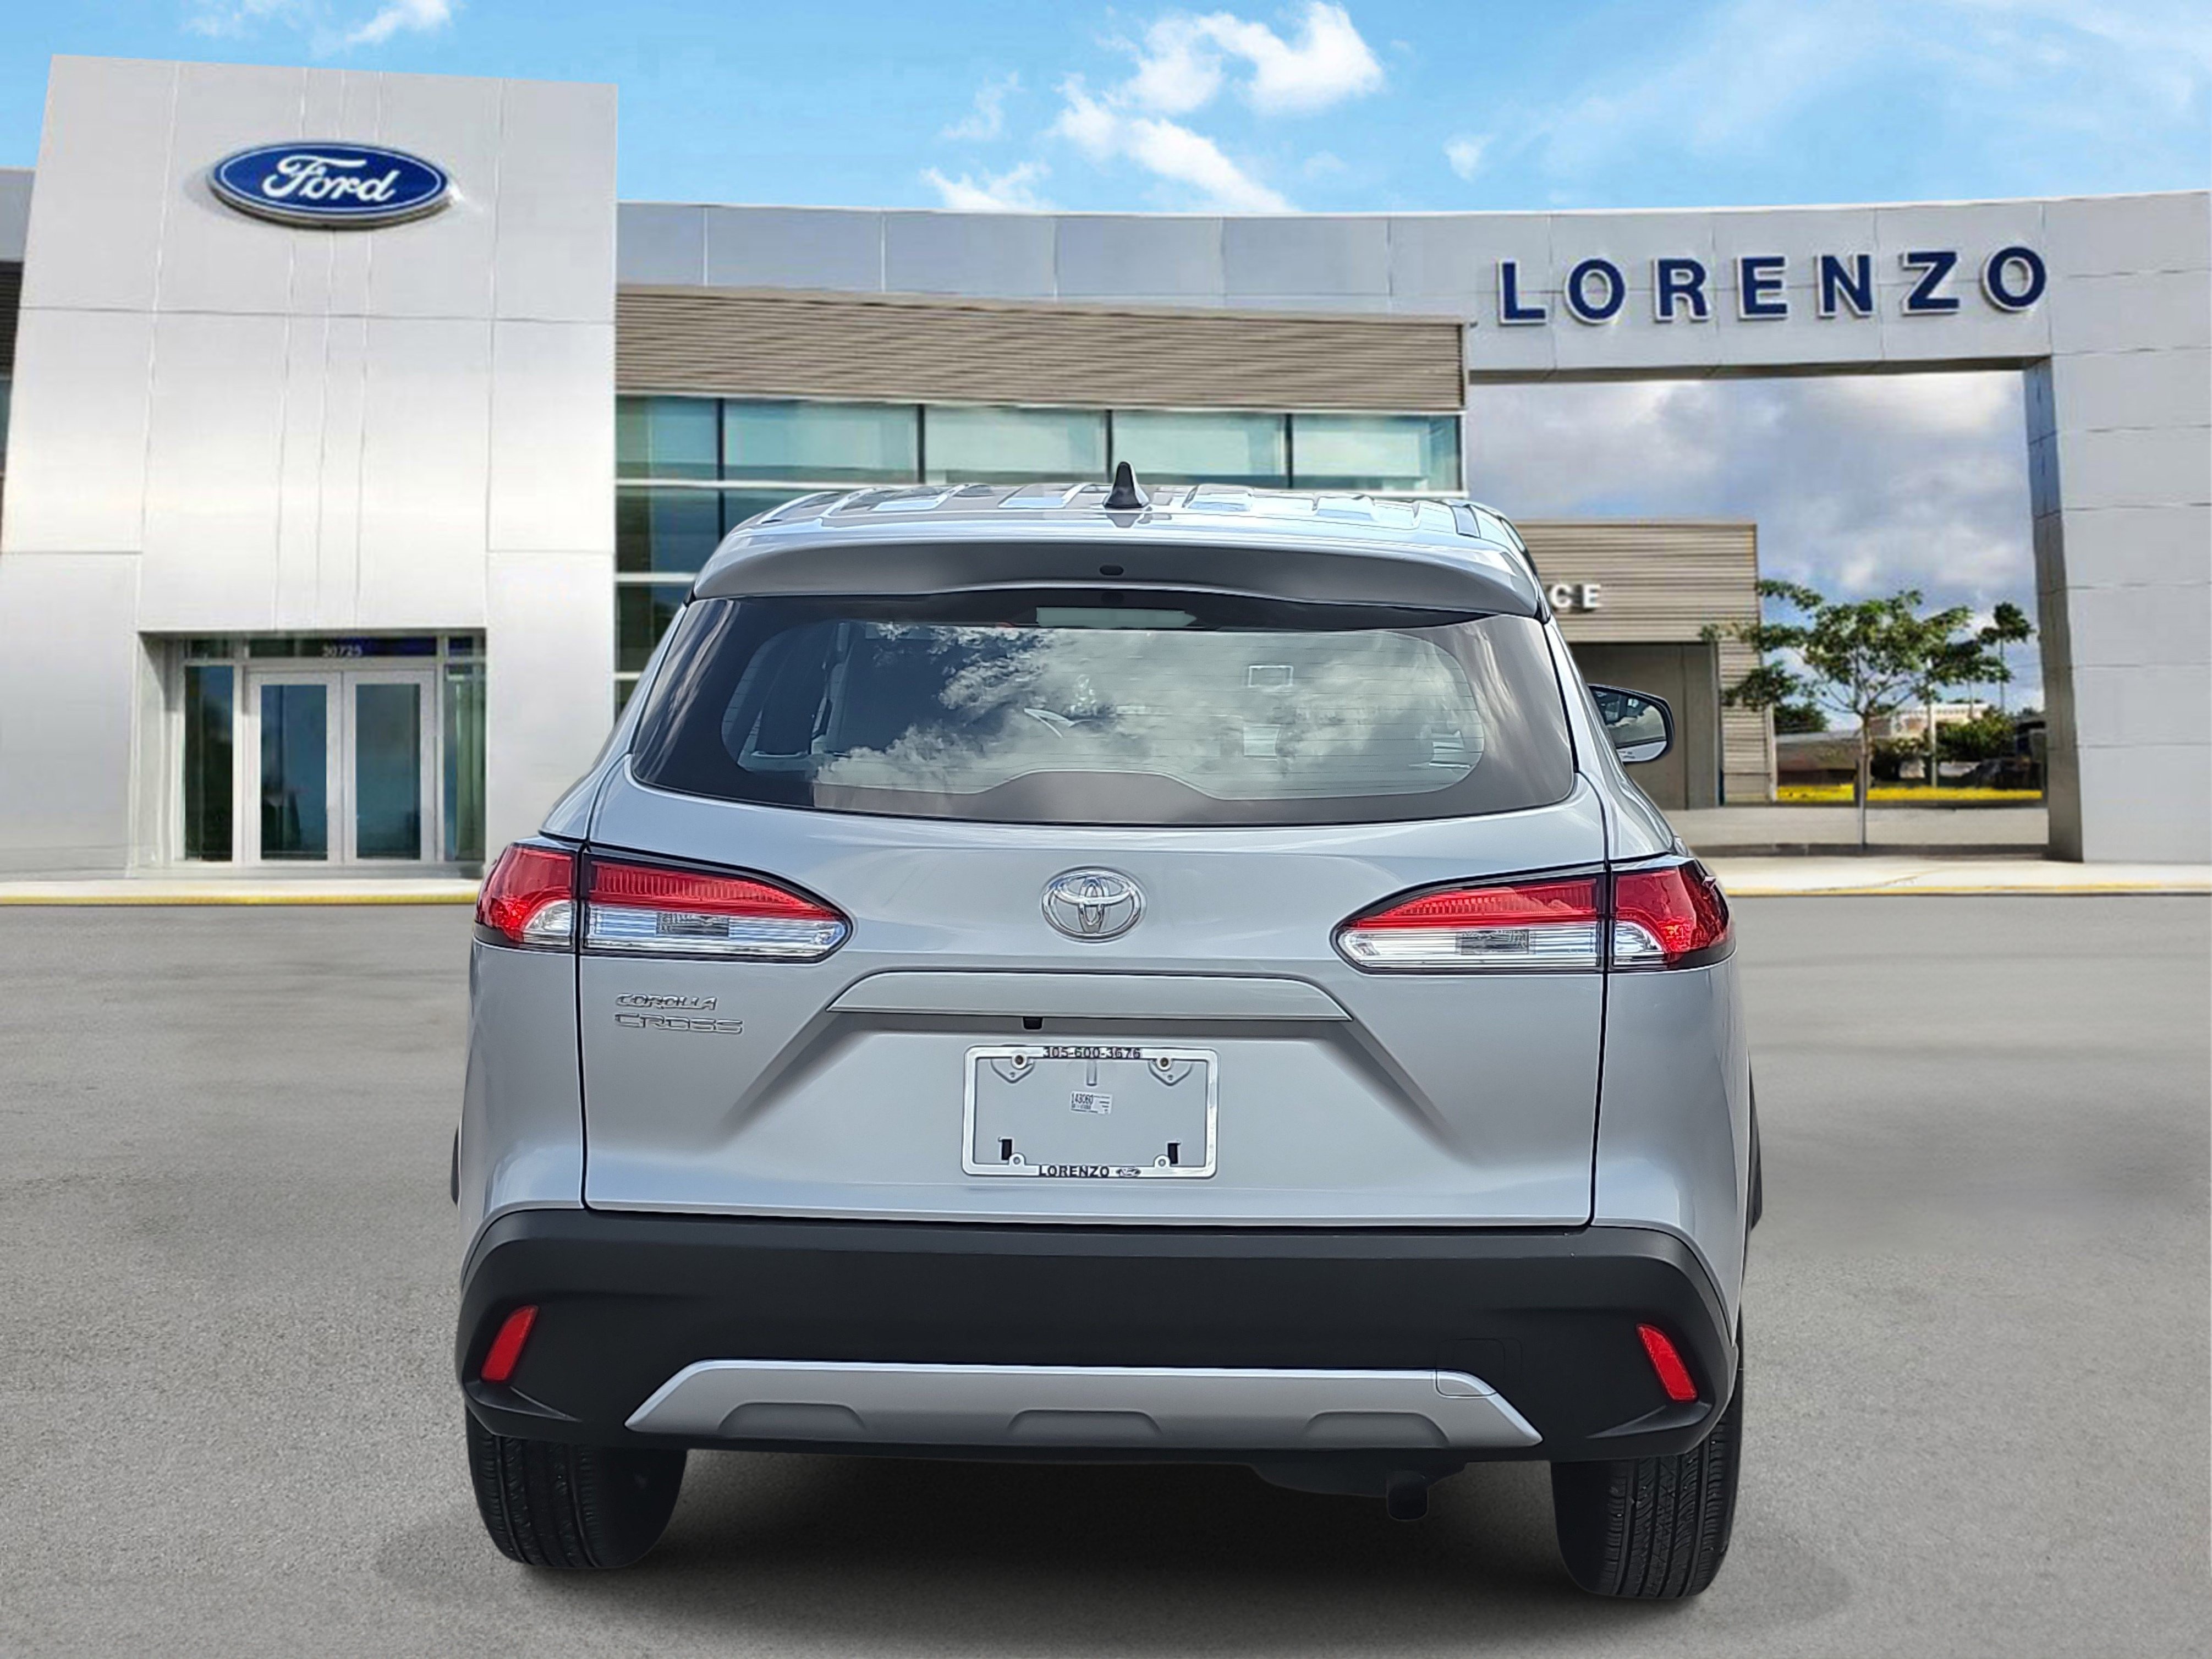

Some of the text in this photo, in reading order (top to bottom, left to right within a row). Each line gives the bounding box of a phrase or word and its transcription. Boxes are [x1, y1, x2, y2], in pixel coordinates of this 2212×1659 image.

[262, 155, 400, 201] Ford
[1497, 246, 2047, 326] LORENZO
[616, 993, 717, 1010] COROLLA
[614, 1013, 743, 1034] CROSS
[1039, 1165, 1110, 1177] LORENZO
